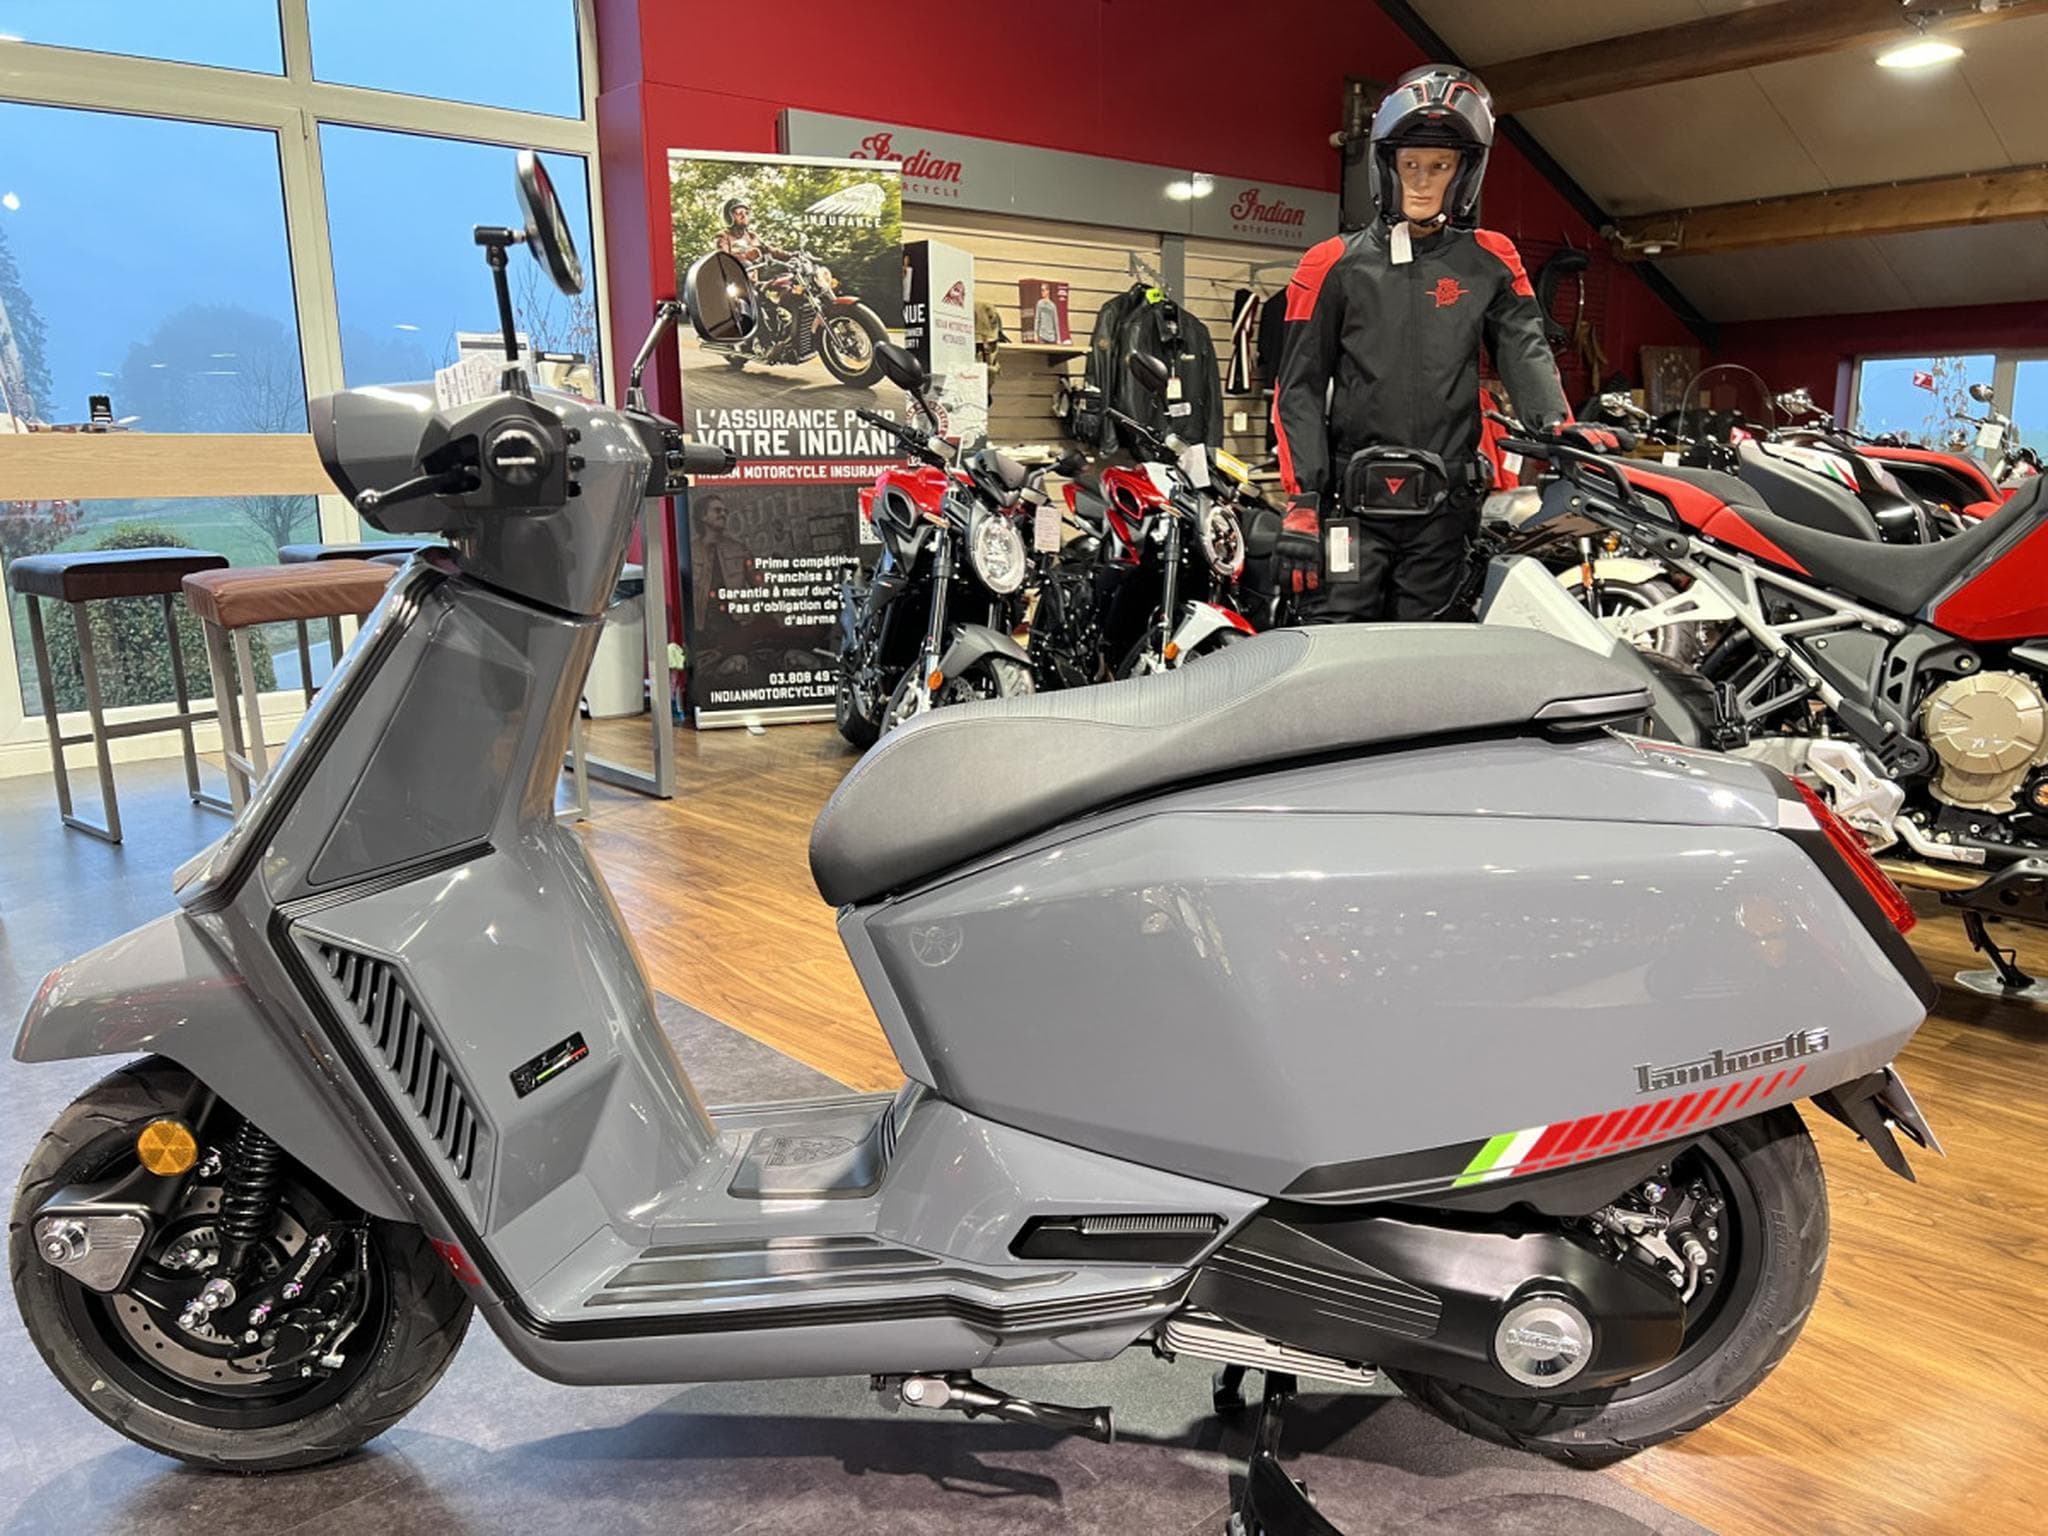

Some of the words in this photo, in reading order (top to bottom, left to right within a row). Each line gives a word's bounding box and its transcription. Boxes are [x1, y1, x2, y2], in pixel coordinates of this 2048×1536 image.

[902, 181, 960, 198] RCYCLE
[1230, 188, 1305, 226] Indian
[803, 214, 882, 228] INSURANCE
[696, 408, 839, 429] L'ASSURANCE
[696, 429, 791, 457] VOTRE
[799, 429, 897, 457] INDIAN!
[743, 465, 827, 480] MOTORCYCLE
[754, 557, 789, 569] Prime
[764, 570, 823, 583] Franchise
[718, 587, 770, 600] Garantie
[782, 585, 810, 597] neuf
[727, 602, 750, 614] Pas
[752, 599, 822, 613] d'obligation
[823, 600, 839, 610] de
[784, 614, 837, 626] d'alarme
[814, 670, 830, 682] 49
[710, 684, 840, 704] INDIANMOTORCYCLEIN
